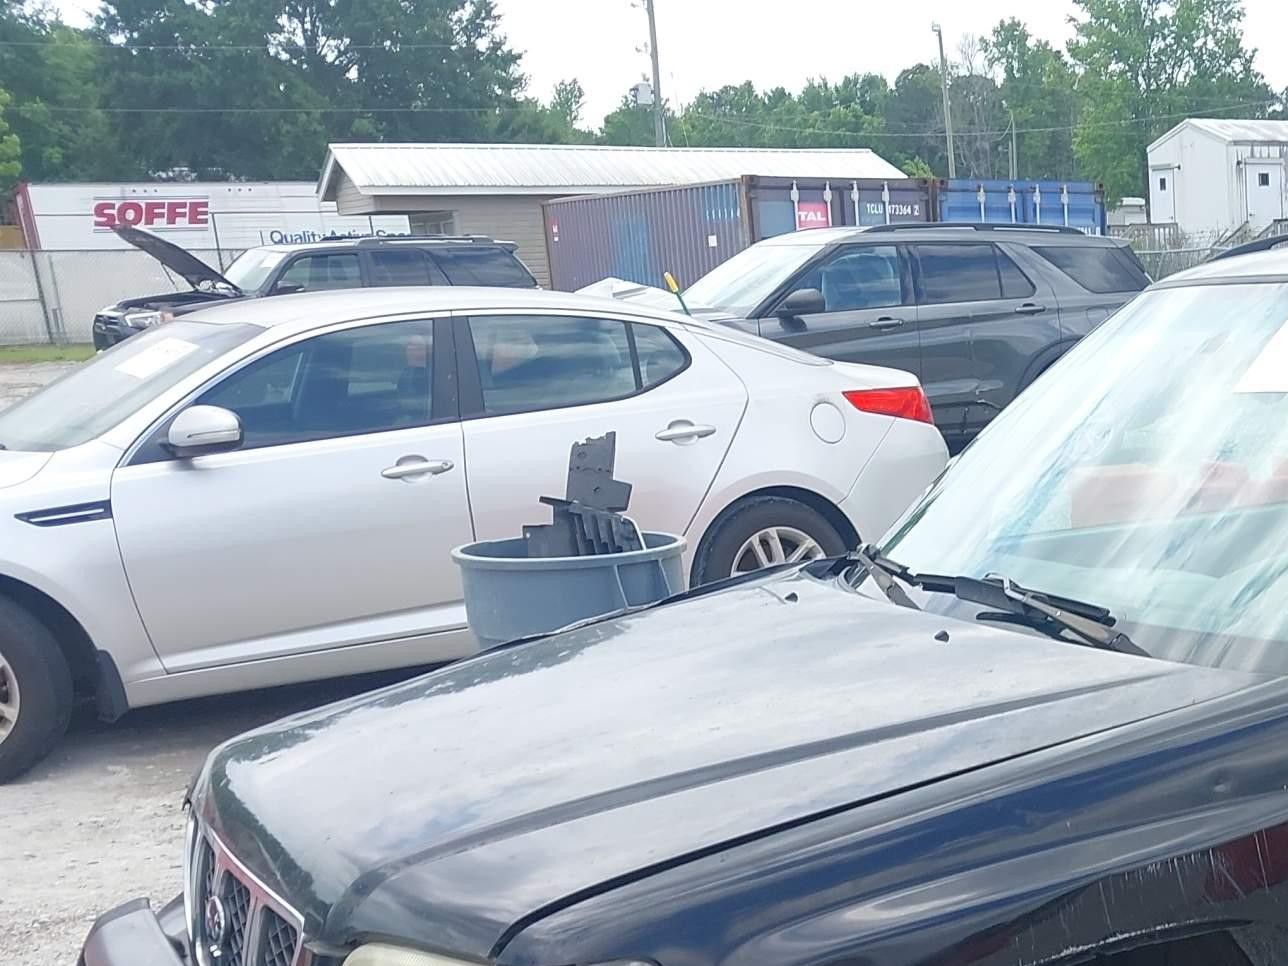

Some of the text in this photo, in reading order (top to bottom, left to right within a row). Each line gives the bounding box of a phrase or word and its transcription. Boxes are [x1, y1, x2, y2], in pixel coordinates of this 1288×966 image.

[94, 201, 209, 227] SOFFE
[799, 211, 826, 221] TAL
[866, 203, 883, 215] TCLU
[913, 204, 920, 216] 2
